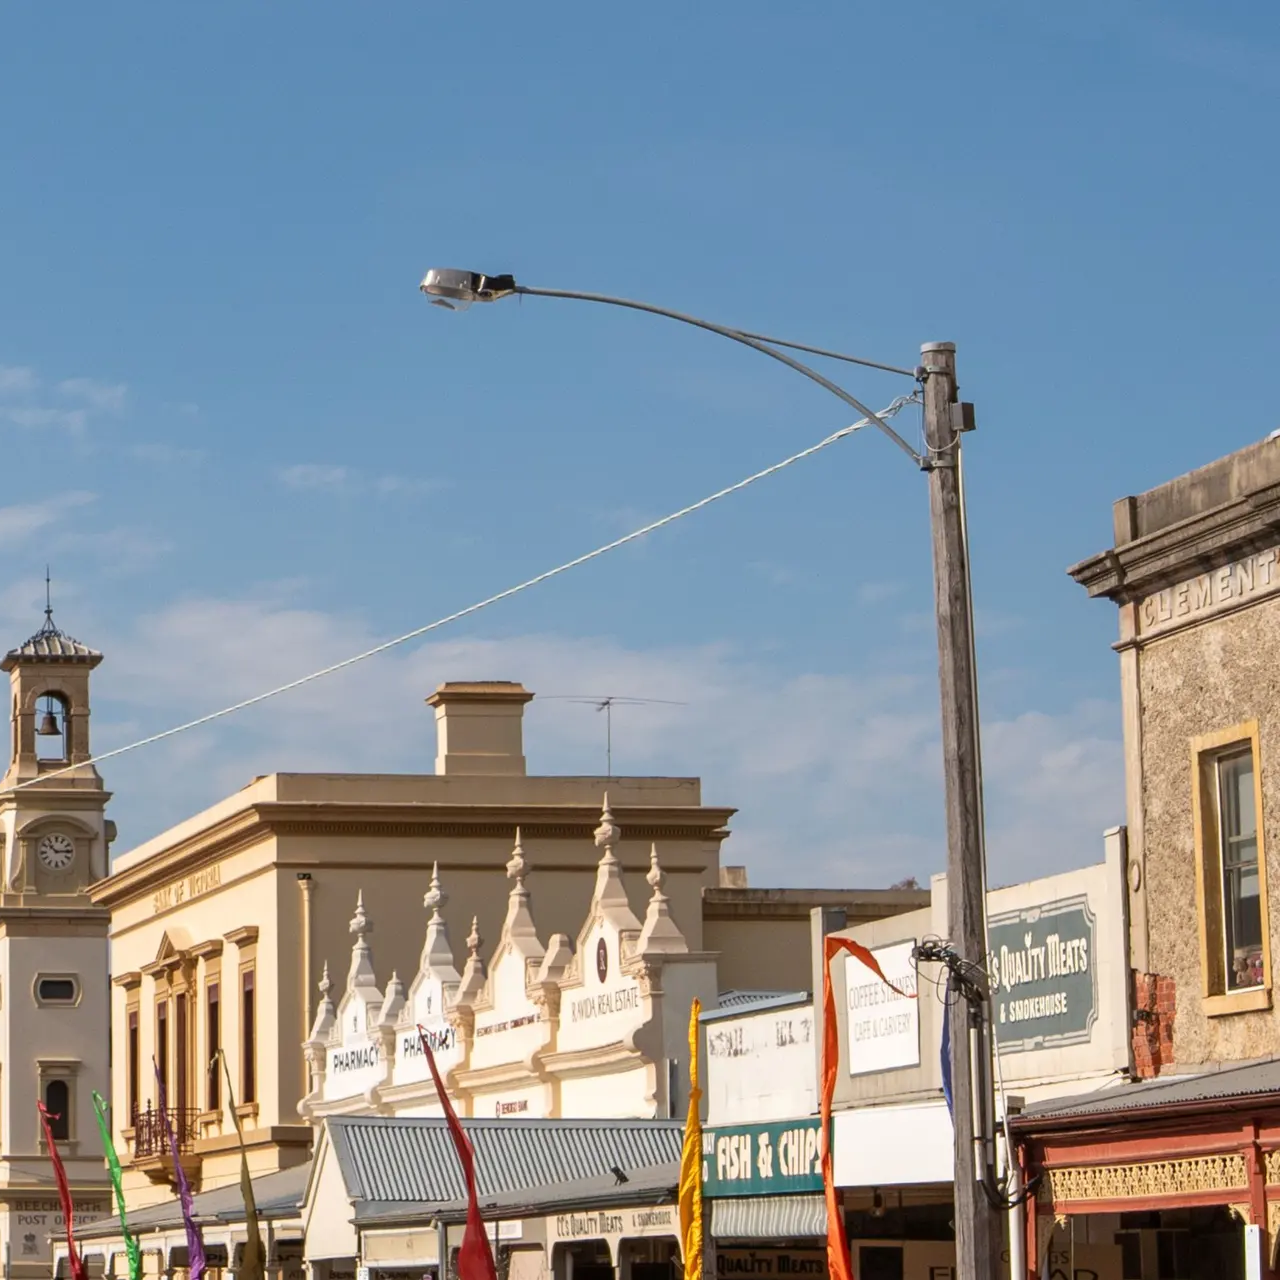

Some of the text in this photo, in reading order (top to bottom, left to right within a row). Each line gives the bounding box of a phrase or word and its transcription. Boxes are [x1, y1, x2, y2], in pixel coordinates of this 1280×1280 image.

[1000, 934, 1045, 993] QUALITY
[1046, 933, 1087, 979] MEATS
[597, 989, 614, 1015] REAL
[614, 986, 639, 1013] ESTATE
[849, 979, 879, 1011] COFFEE
[1009, 992, 1068, 1022] SMOKEHOUSE
[333, 1043, 380, 1074] PHARMACY
[717, 1133, 752, 1181] FISH
[17, 1213, 47, 1226] POST
[716, 1252, 824, 1276] QUALITY MEATS
